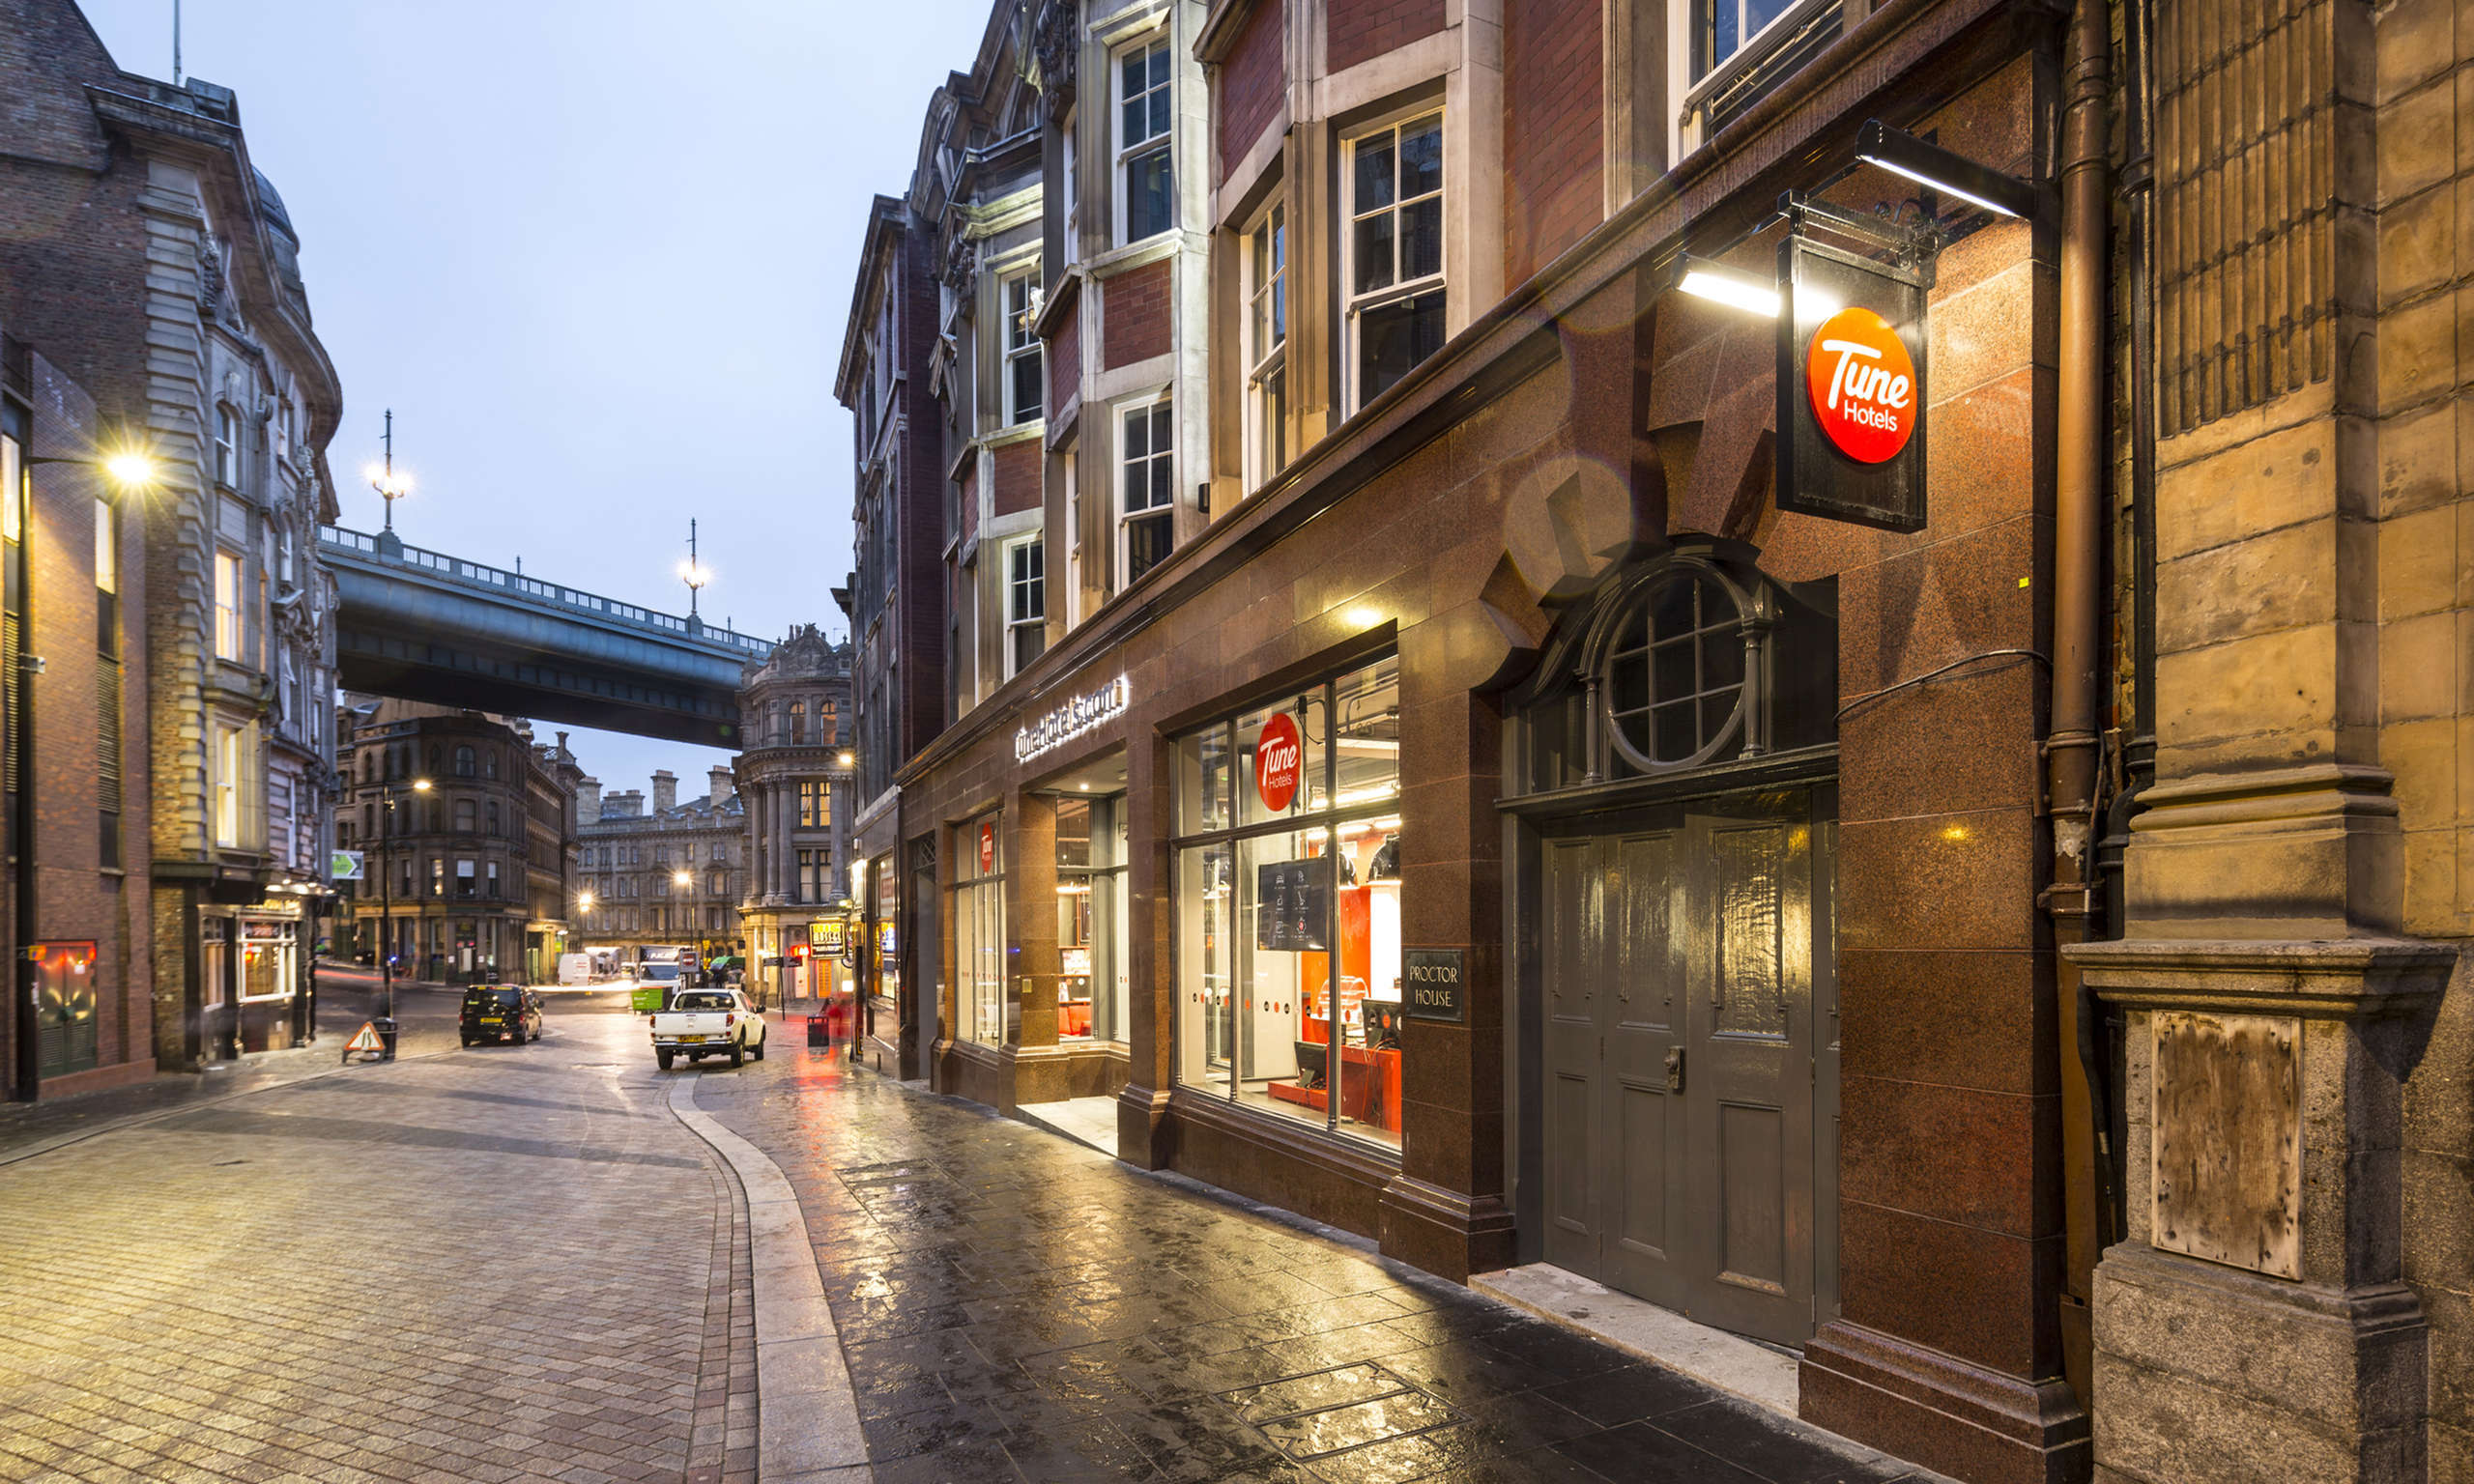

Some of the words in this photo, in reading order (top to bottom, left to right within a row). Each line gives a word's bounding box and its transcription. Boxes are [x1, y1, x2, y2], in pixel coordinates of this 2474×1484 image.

[1822, 339, 1910, 410] Tune
[1844, 399, 1898, 432] Hotels
[1259, 736, 1298, 787] Tune
[1268, 773, 1292, 789] Hotels
[1409, 965, 1458, 984] PROCTOR
[1415, 988, 1453, 1007] HOUSE
